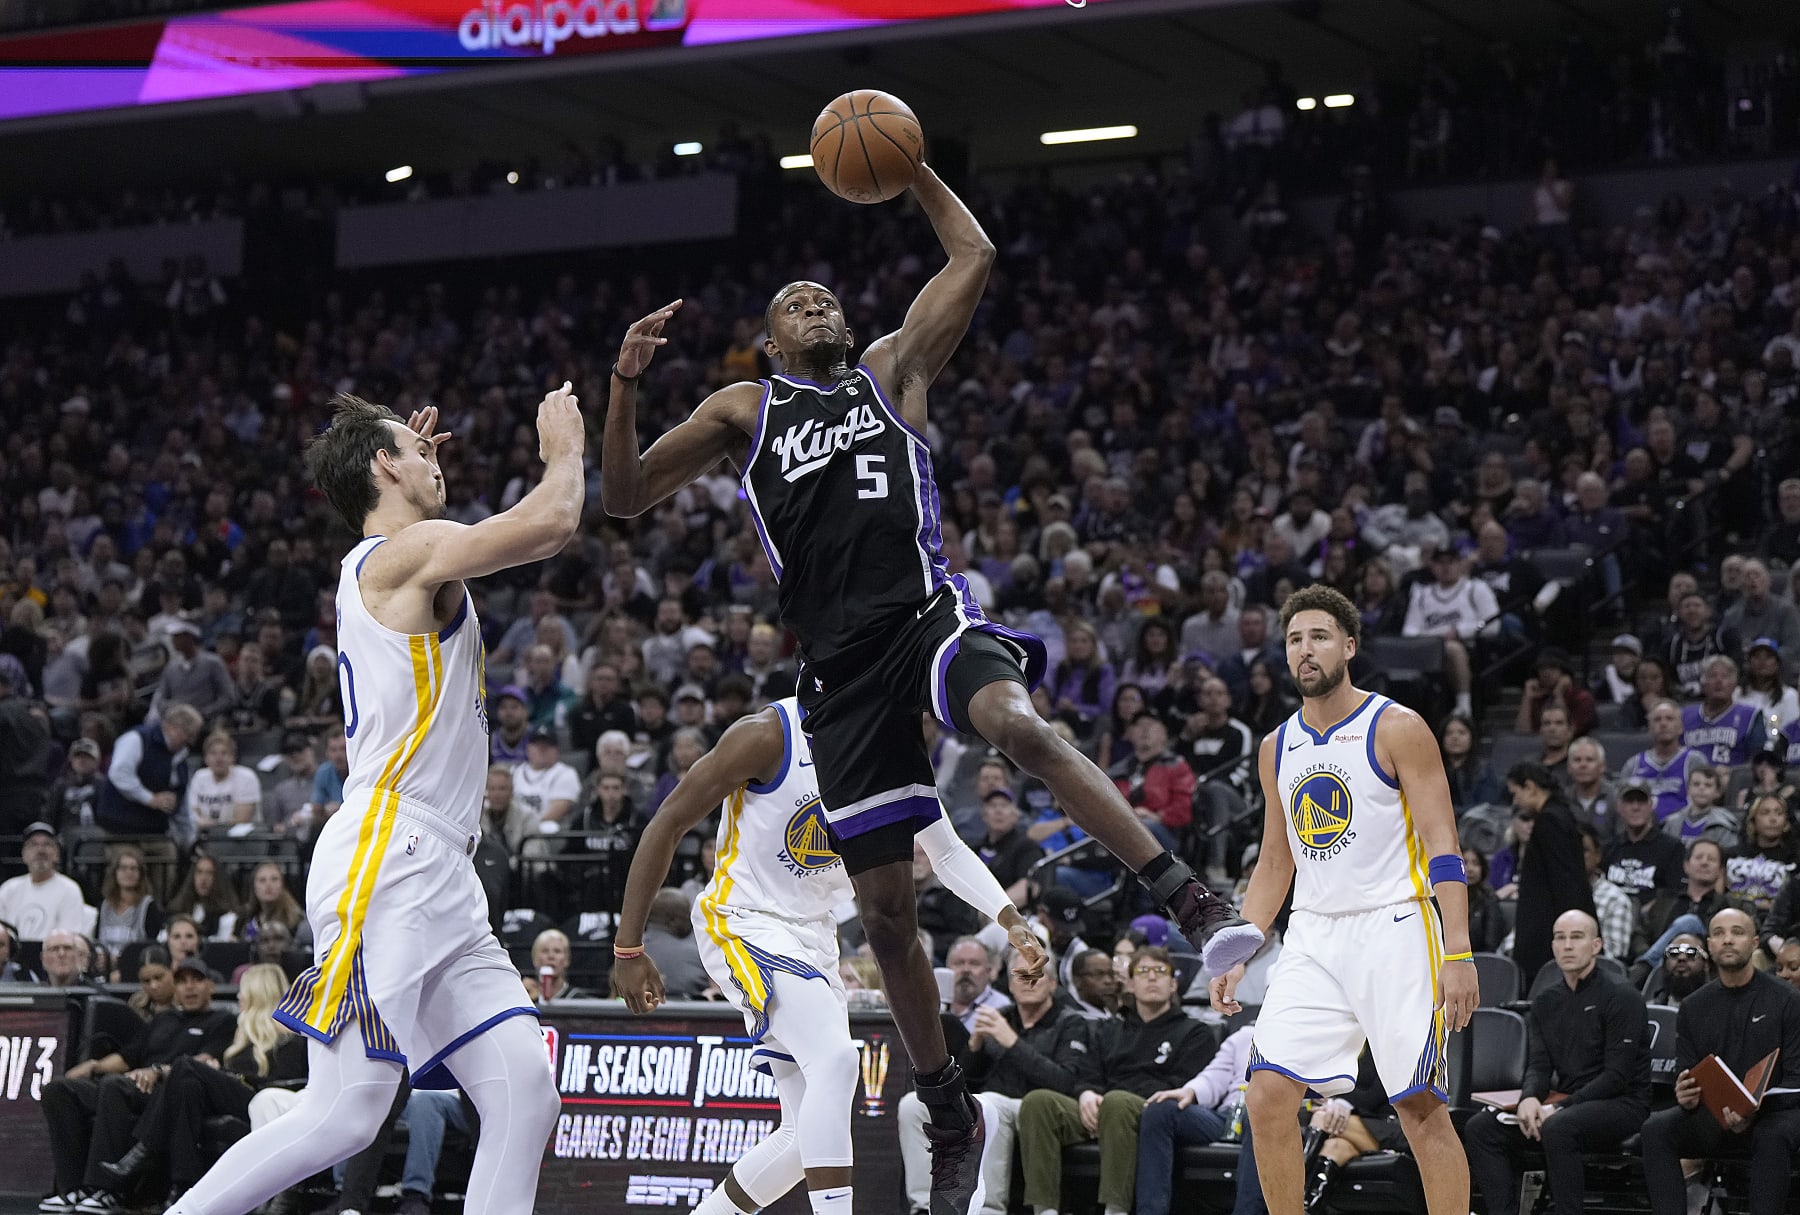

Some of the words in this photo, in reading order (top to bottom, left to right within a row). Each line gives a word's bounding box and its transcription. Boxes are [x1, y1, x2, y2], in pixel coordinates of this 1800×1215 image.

[771, 404, 886, 483] Kings
[856, 455, 888, 499] 5
[1335, 734, 1363, 744] Rakuten
[1288, 762, 1325, 791] GOLDEN
[1328, 763, 1352, 784] STATE
[794, 790, 818, 807] GOL
[1331, 789, 1340, 811] 11
[1301, 829, 1357, 861] ARRIORS
[776, 849, 842, 879] WARRIOR
[30, 1036, 58, 1101] 3
[559, 1044, 693, 1096] IN-SEASON
[693, 1036, 779, 1107] TOURN
[553, 1113, 627, 1159] GAMES
[626, 1115, 692, 1162] BEGIN
